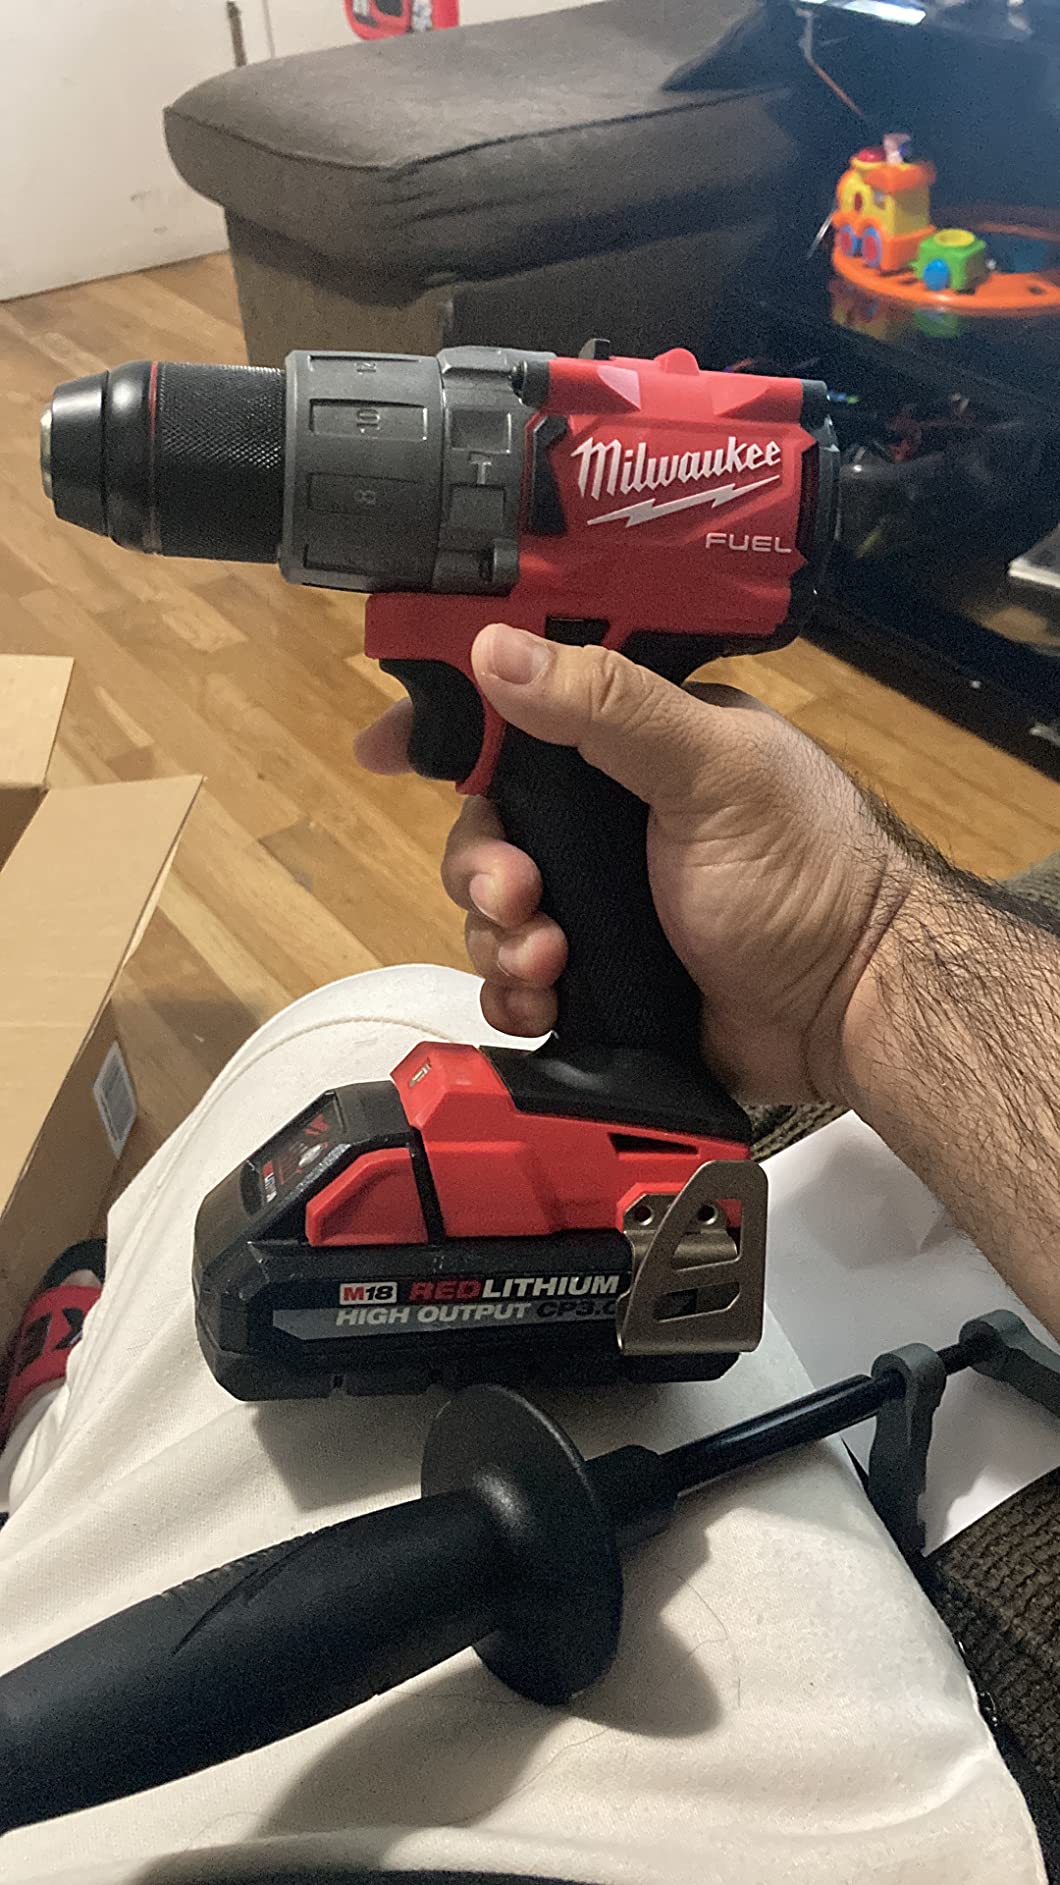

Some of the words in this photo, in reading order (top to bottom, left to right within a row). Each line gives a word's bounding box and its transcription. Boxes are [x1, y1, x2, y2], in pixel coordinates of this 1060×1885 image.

[570, 436, 781, 500] Milwaukee
[705, 532, 792, 553] FUEL
[341, 1283, 395, 1302] M18
[409, 1274, 620, 1301] REDLITHIUM
[335, 1306, 411, 1326] HIGH
[416, 1302, 532, 1324] OUTPUT
